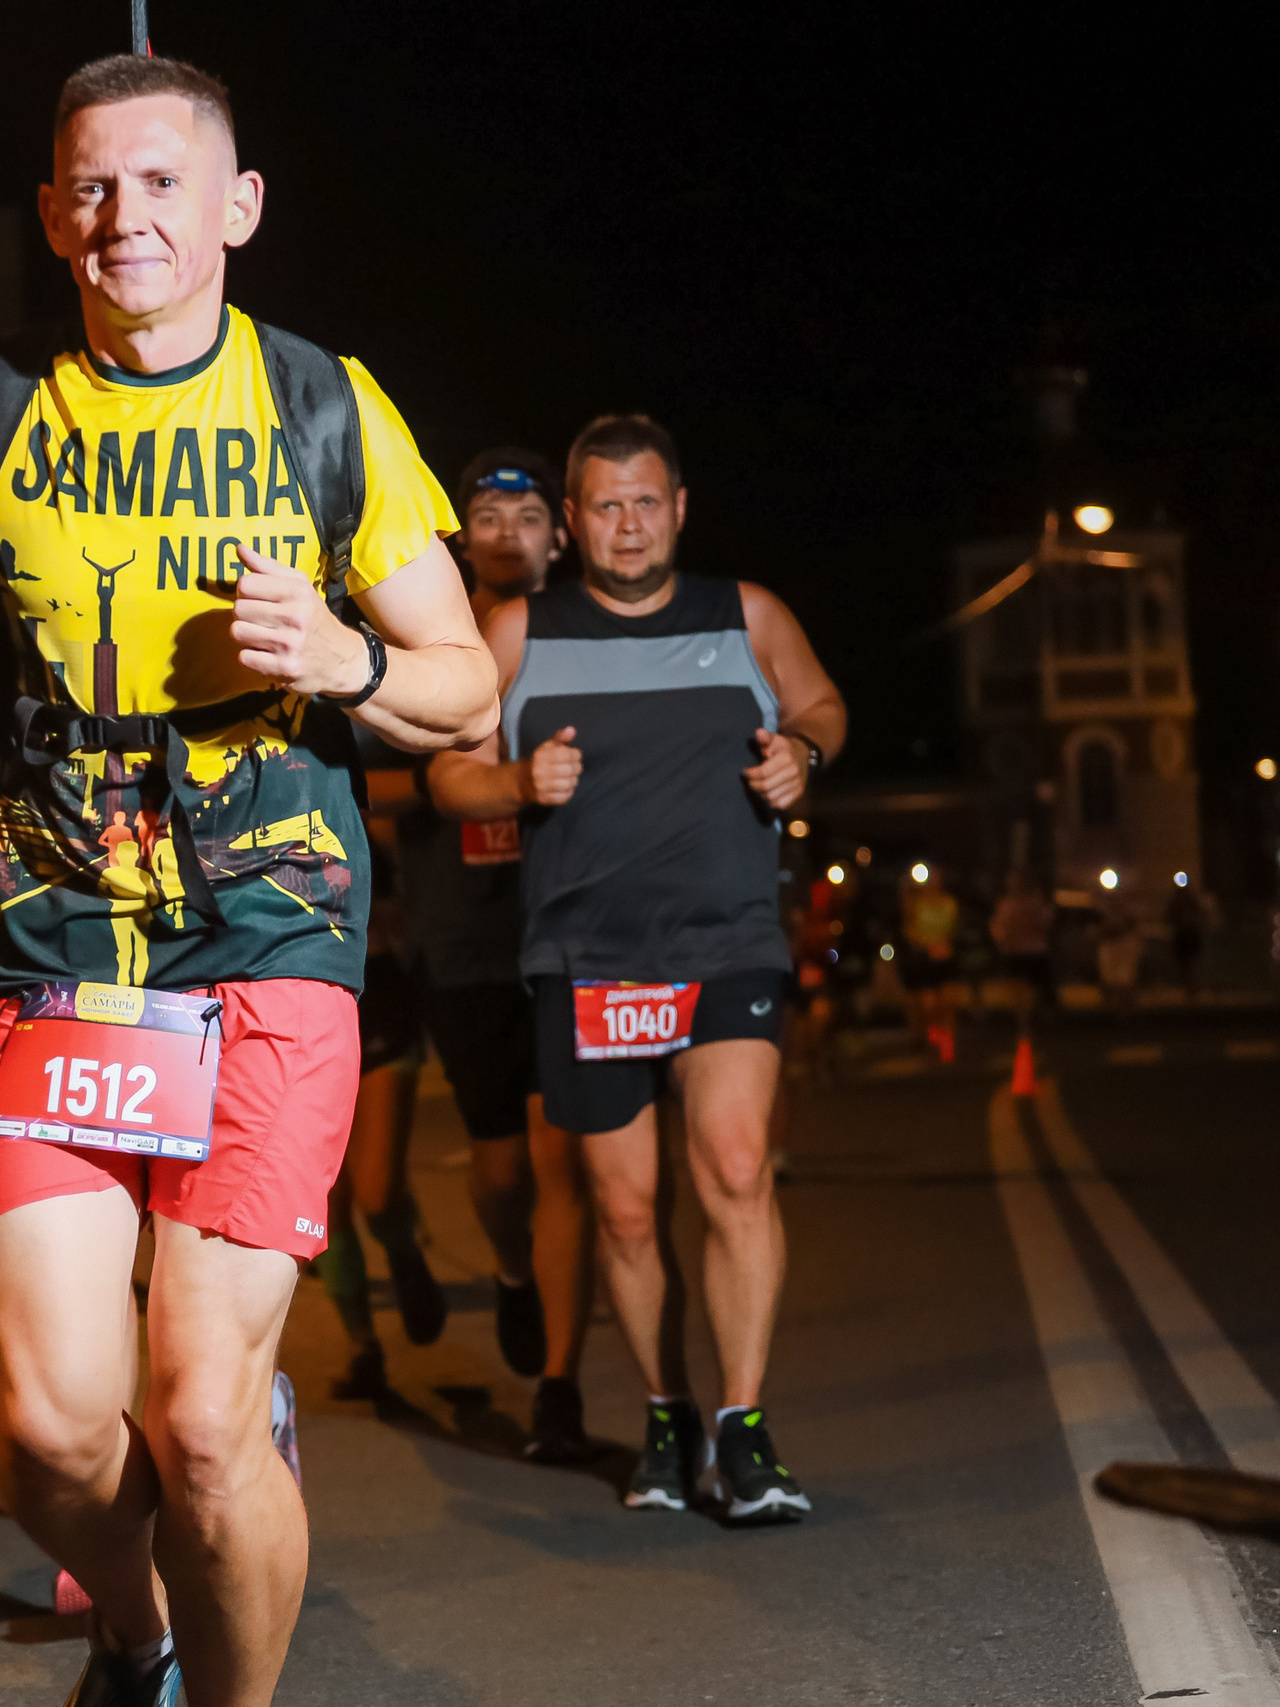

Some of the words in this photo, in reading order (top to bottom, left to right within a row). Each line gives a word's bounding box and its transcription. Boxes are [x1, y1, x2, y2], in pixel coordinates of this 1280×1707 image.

[11, 420, 305, 518] SAMARA
[82, 996, 136, 1011] САМАРЫ
[602, 1003, 678, 1042] 1040
[43, 1056, 158, 1124] 1512
